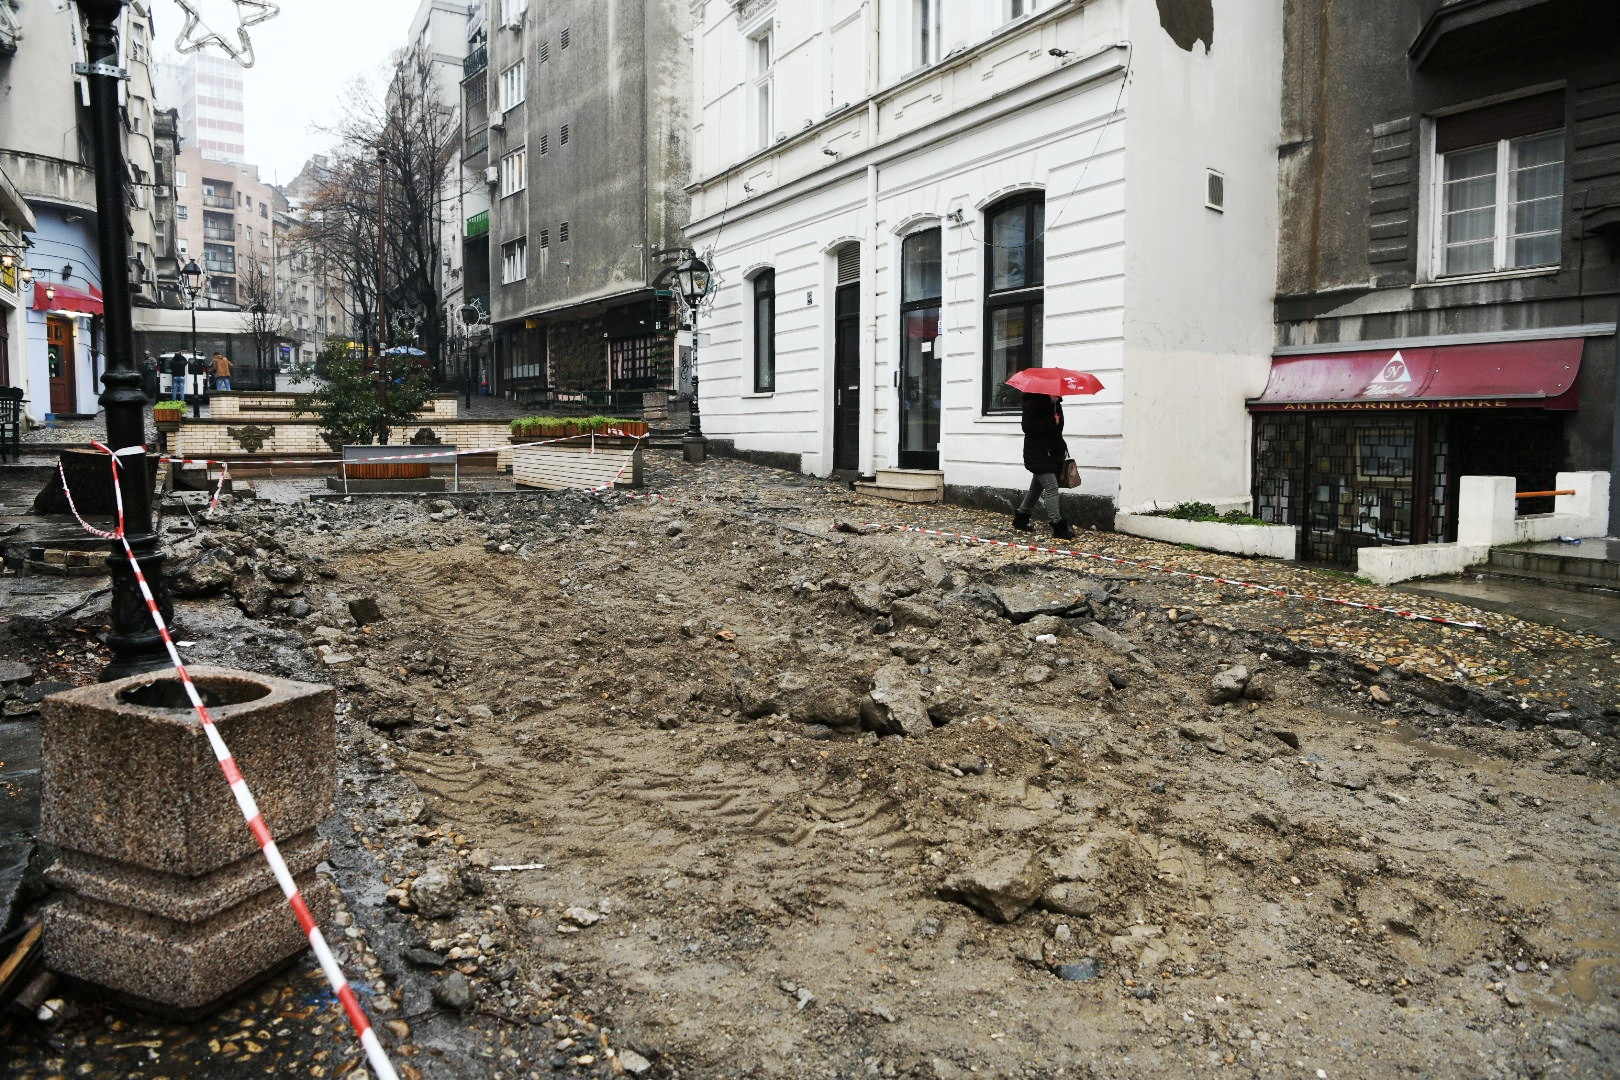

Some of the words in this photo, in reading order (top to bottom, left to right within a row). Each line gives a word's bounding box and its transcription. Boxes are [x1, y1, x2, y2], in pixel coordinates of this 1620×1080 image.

[1385, 366, 1403, 379] N
[1284, 402, 1429, 411] ANTIKVARNICA
[1438, 399, 1507, 408] NINKE
